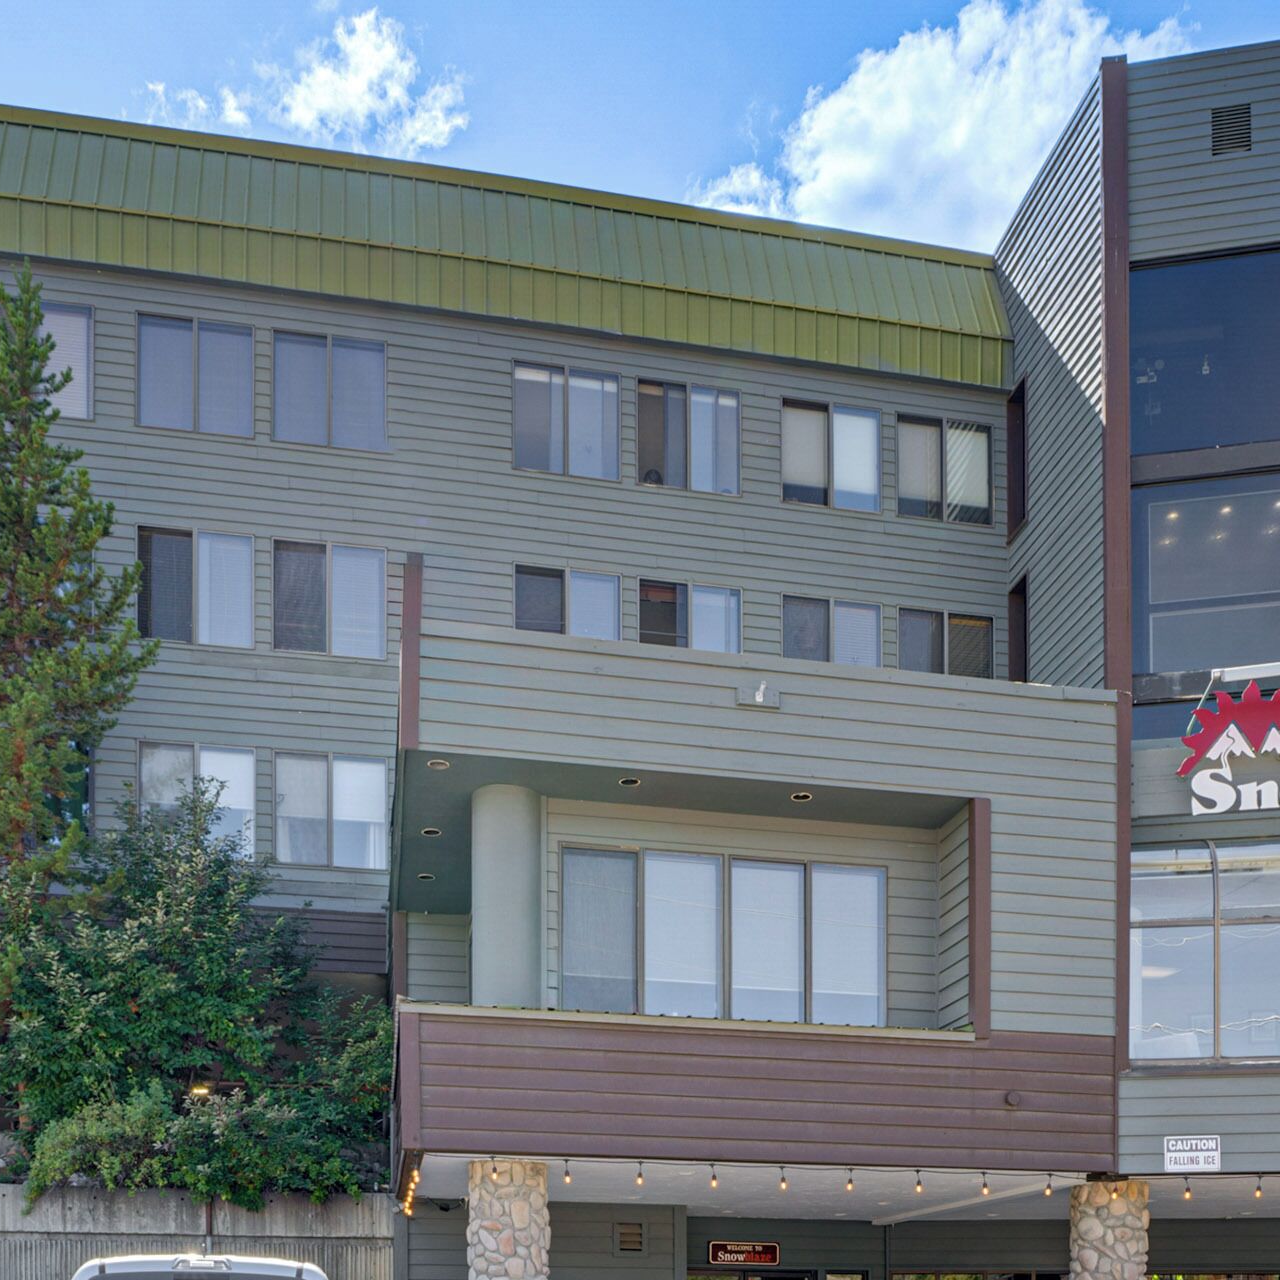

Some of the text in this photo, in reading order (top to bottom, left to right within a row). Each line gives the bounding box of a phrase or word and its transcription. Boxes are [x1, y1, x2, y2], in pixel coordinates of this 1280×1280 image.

[1168, 1139, 1216, 1151] CAUTION
[1169, 1155, 1216, 1166] FALLING ICE
[717, 1251, 772, 1261] Snowblaze
